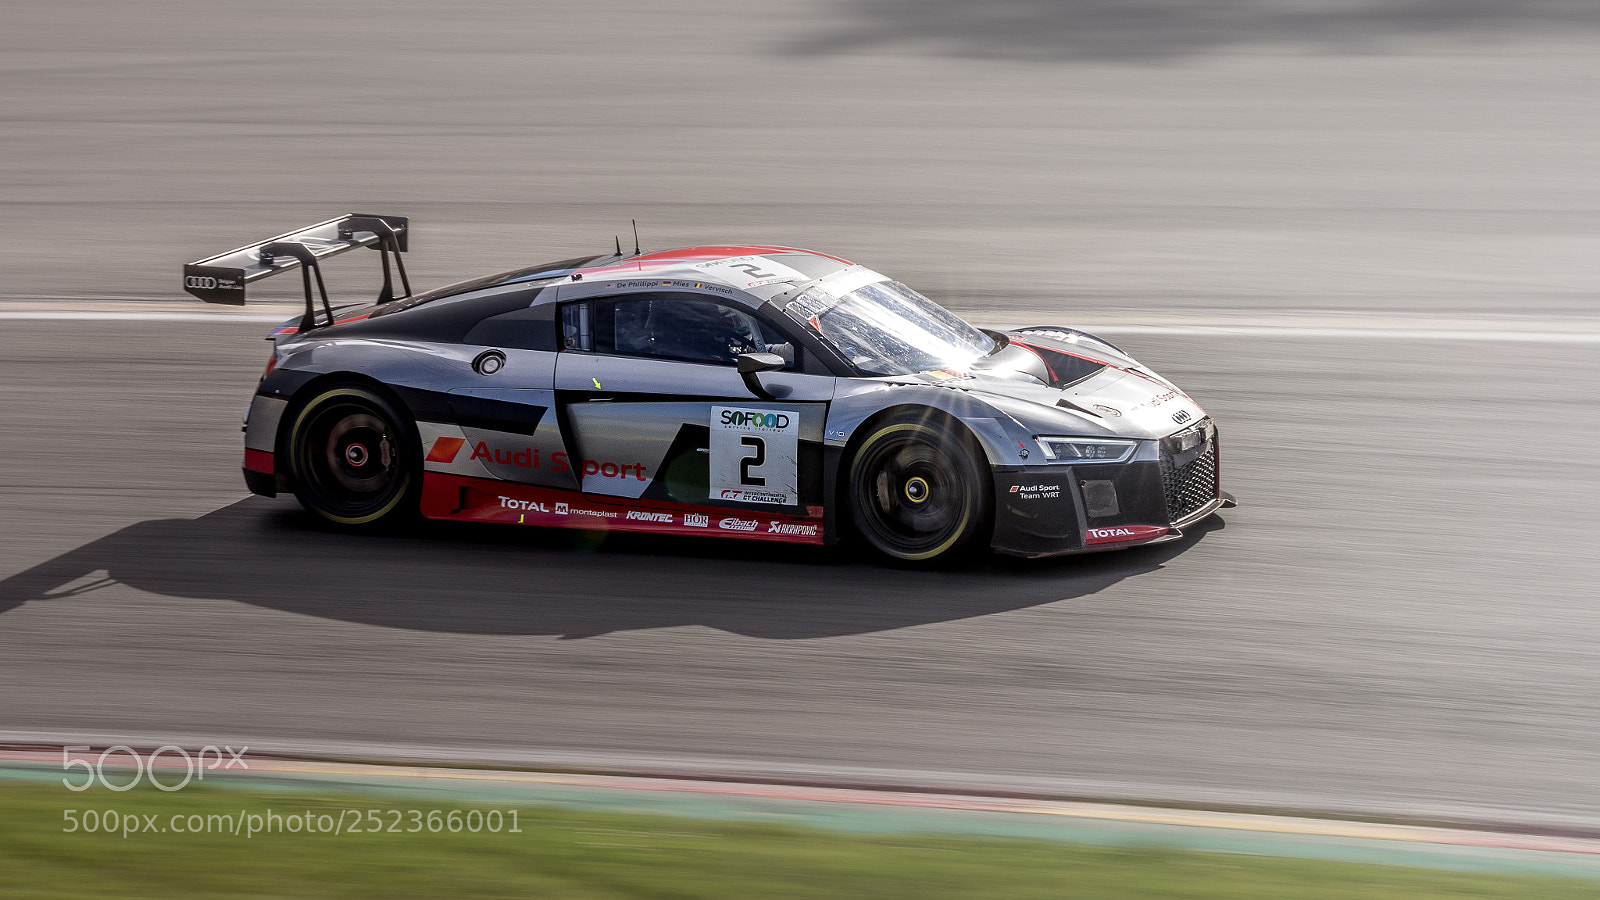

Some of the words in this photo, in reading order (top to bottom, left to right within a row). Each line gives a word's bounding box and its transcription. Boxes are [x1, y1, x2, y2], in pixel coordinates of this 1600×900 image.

[728, 263, 777, 278] 2
[705, 284, 733, 295] Vervisch
[720, 410, 790, 429] SOFOOD
[470, 441, 540, 469] Audi
[551, 451, 647, 482] Sport
[740, 436, 766, 487] 2
[752, 496, 788, 504] CHALLENGE
[1042, 491, 1060, 499] WRT
[498, 496, 549, 512] TOTAL
[570, 508, 618, 518] montaplast
[626, 511, 674, 523] KRONTEC
[718, 517, 759, 531] Eibach
[1088, 528, 1135, 538] TOTAL
